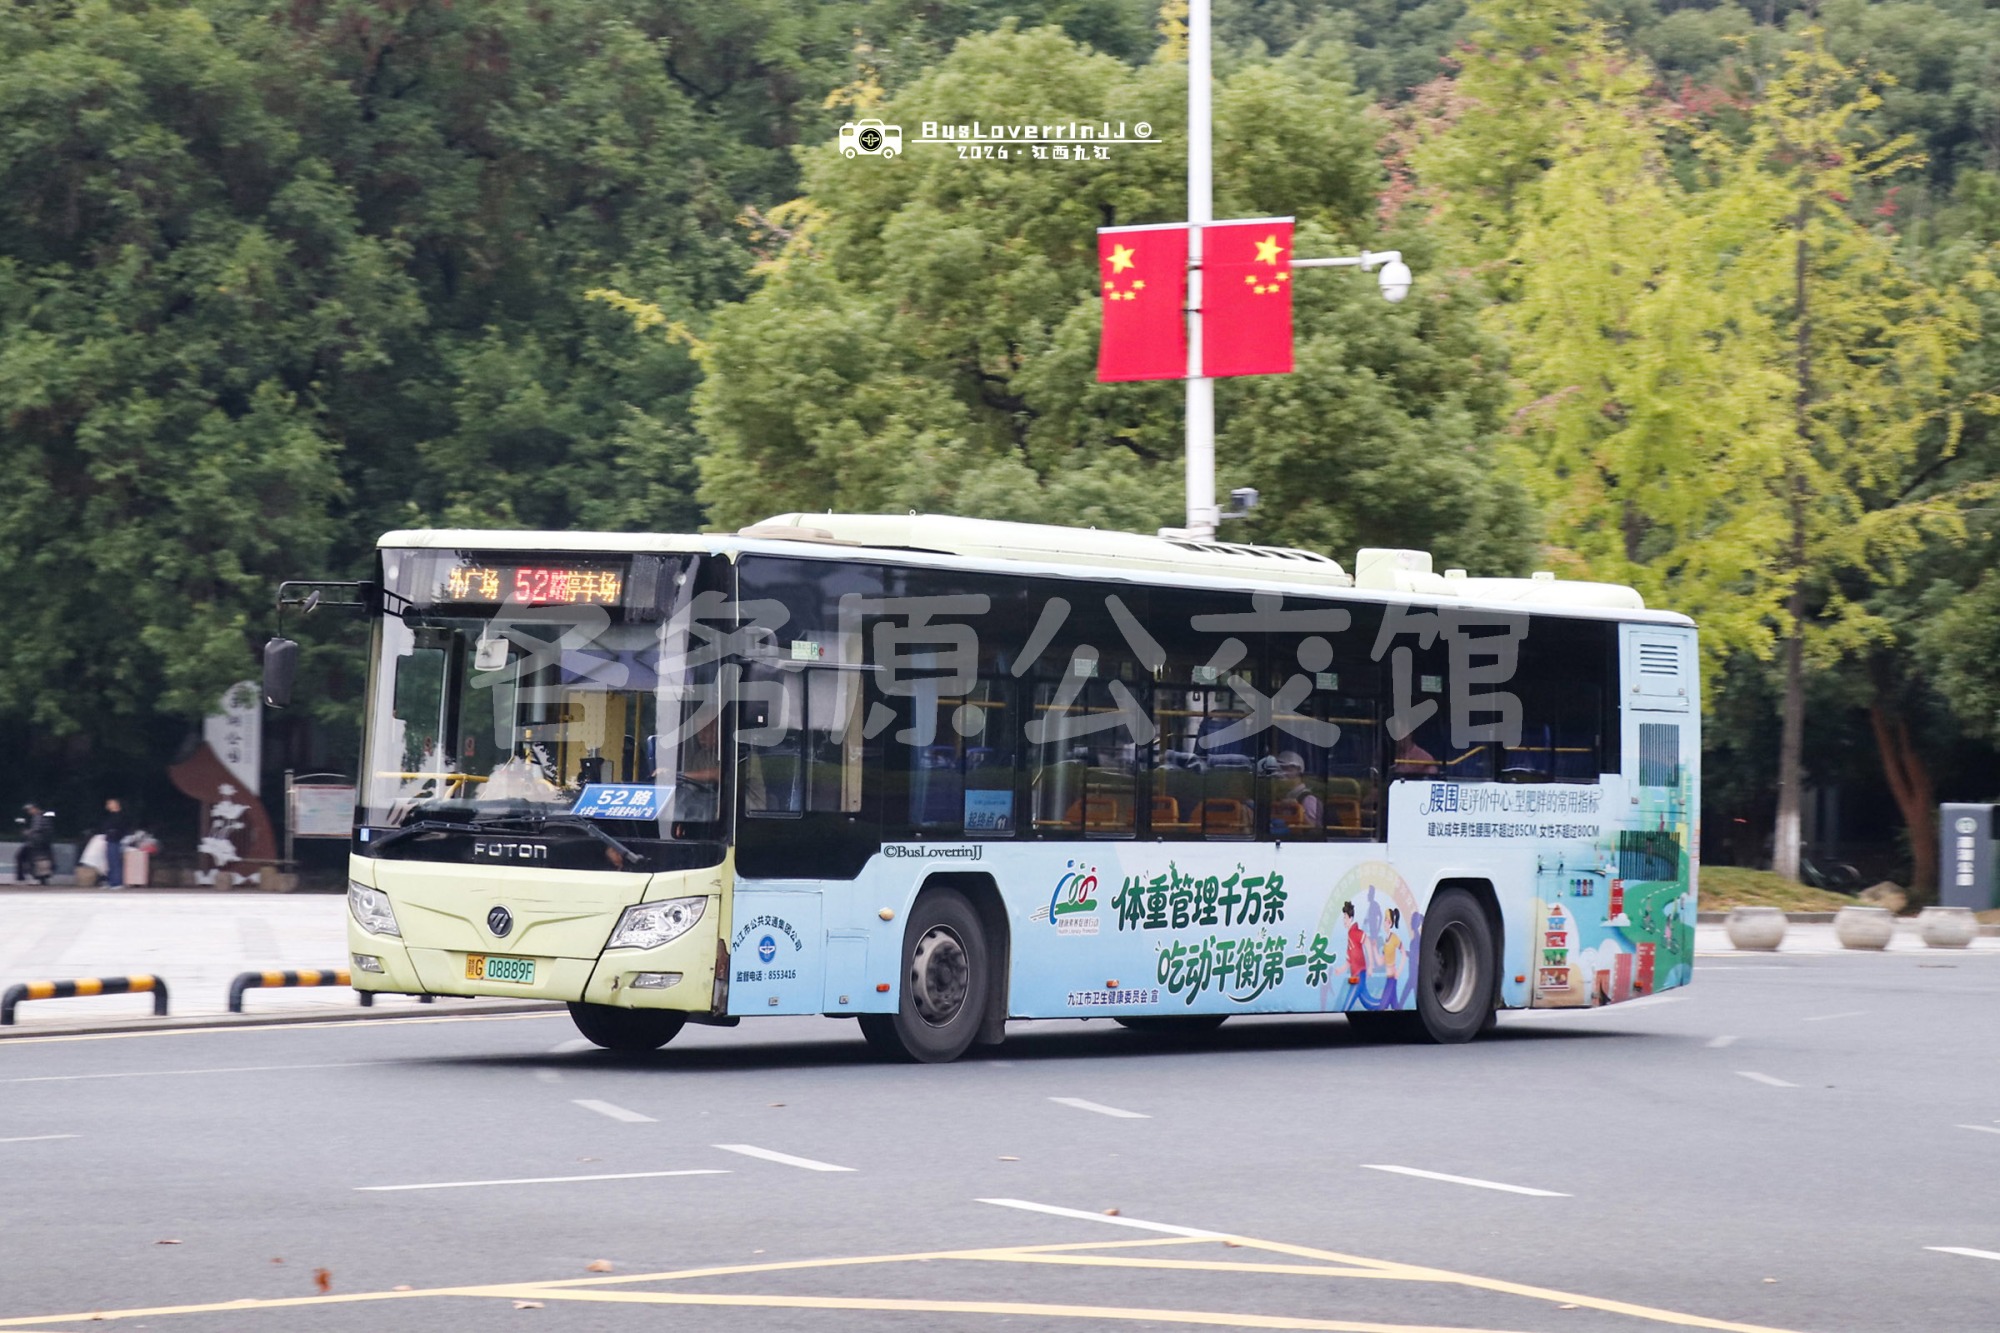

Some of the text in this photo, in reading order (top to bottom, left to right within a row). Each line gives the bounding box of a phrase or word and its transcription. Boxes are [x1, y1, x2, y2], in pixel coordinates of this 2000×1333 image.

[474, 843, 548, 859] FOTON
[1112, 866, 1288, 931] 体重管理千万条
[732, 915, 803, 952] 九江市公共交通集团公司
[1156, 933, 1336, 1005] 吃动平衡第一条
[1067, 989, 1159, 1006] 九江市卫生健康委员会 宣
